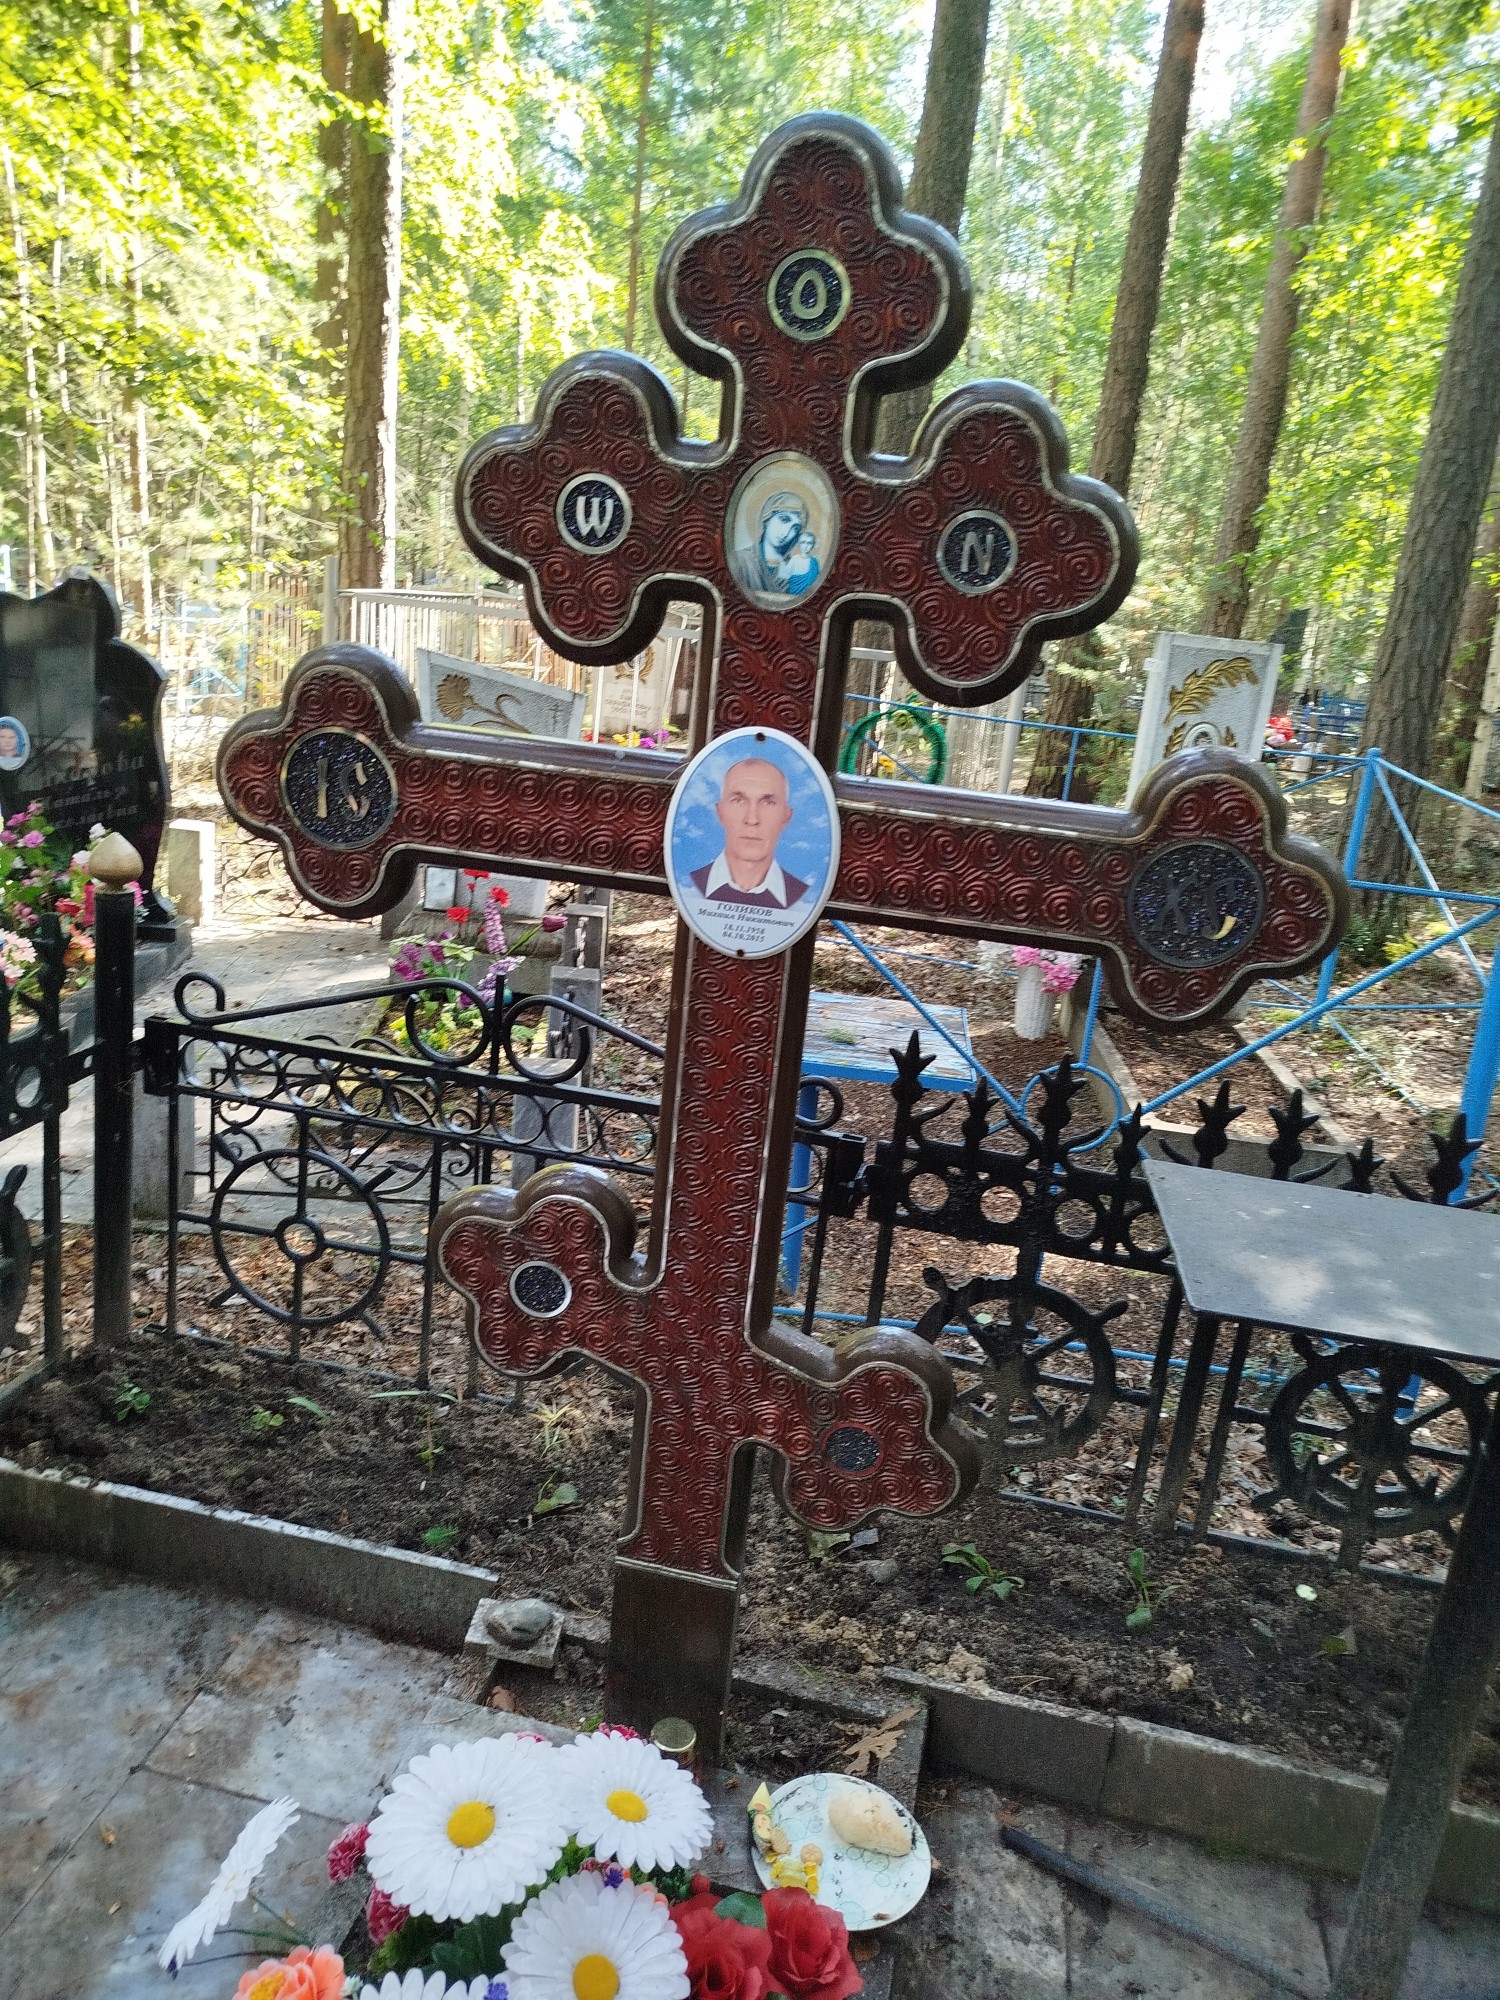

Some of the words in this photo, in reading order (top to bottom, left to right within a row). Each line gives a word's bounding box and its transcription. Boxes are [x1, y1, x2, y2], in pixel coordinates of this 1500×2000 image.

[960, 531, 995, 576] N
[698, 908, 735, 919] Михаил
[716, 903, 773, 916] ГОЛИКОВ
